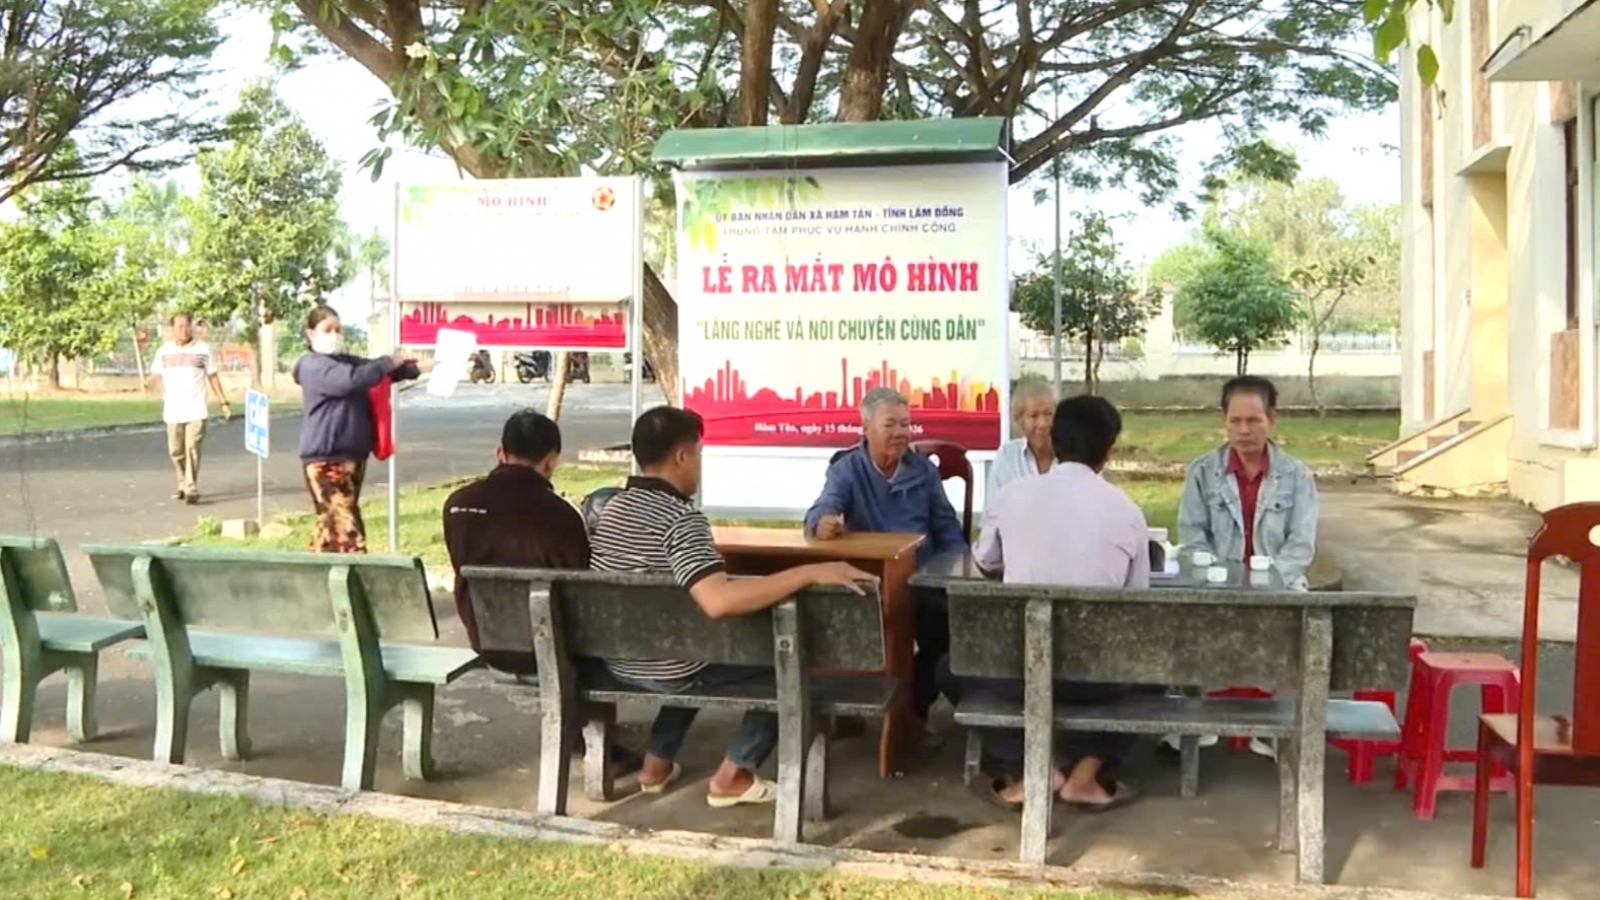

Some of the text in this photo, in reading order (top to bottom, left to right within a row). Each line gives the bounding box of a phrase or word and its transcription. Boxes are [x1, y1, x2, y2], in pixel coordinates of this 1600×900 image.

[731, 212, 752, 221] BAN
[741, 264, 777, 293] RA
[853, 256, 898, 292] MÔ
[907, 255, 979, 292] HÌNH
[744, 319, 782, 341] NGHE
[900, 314, 941, 341] CÙNG
